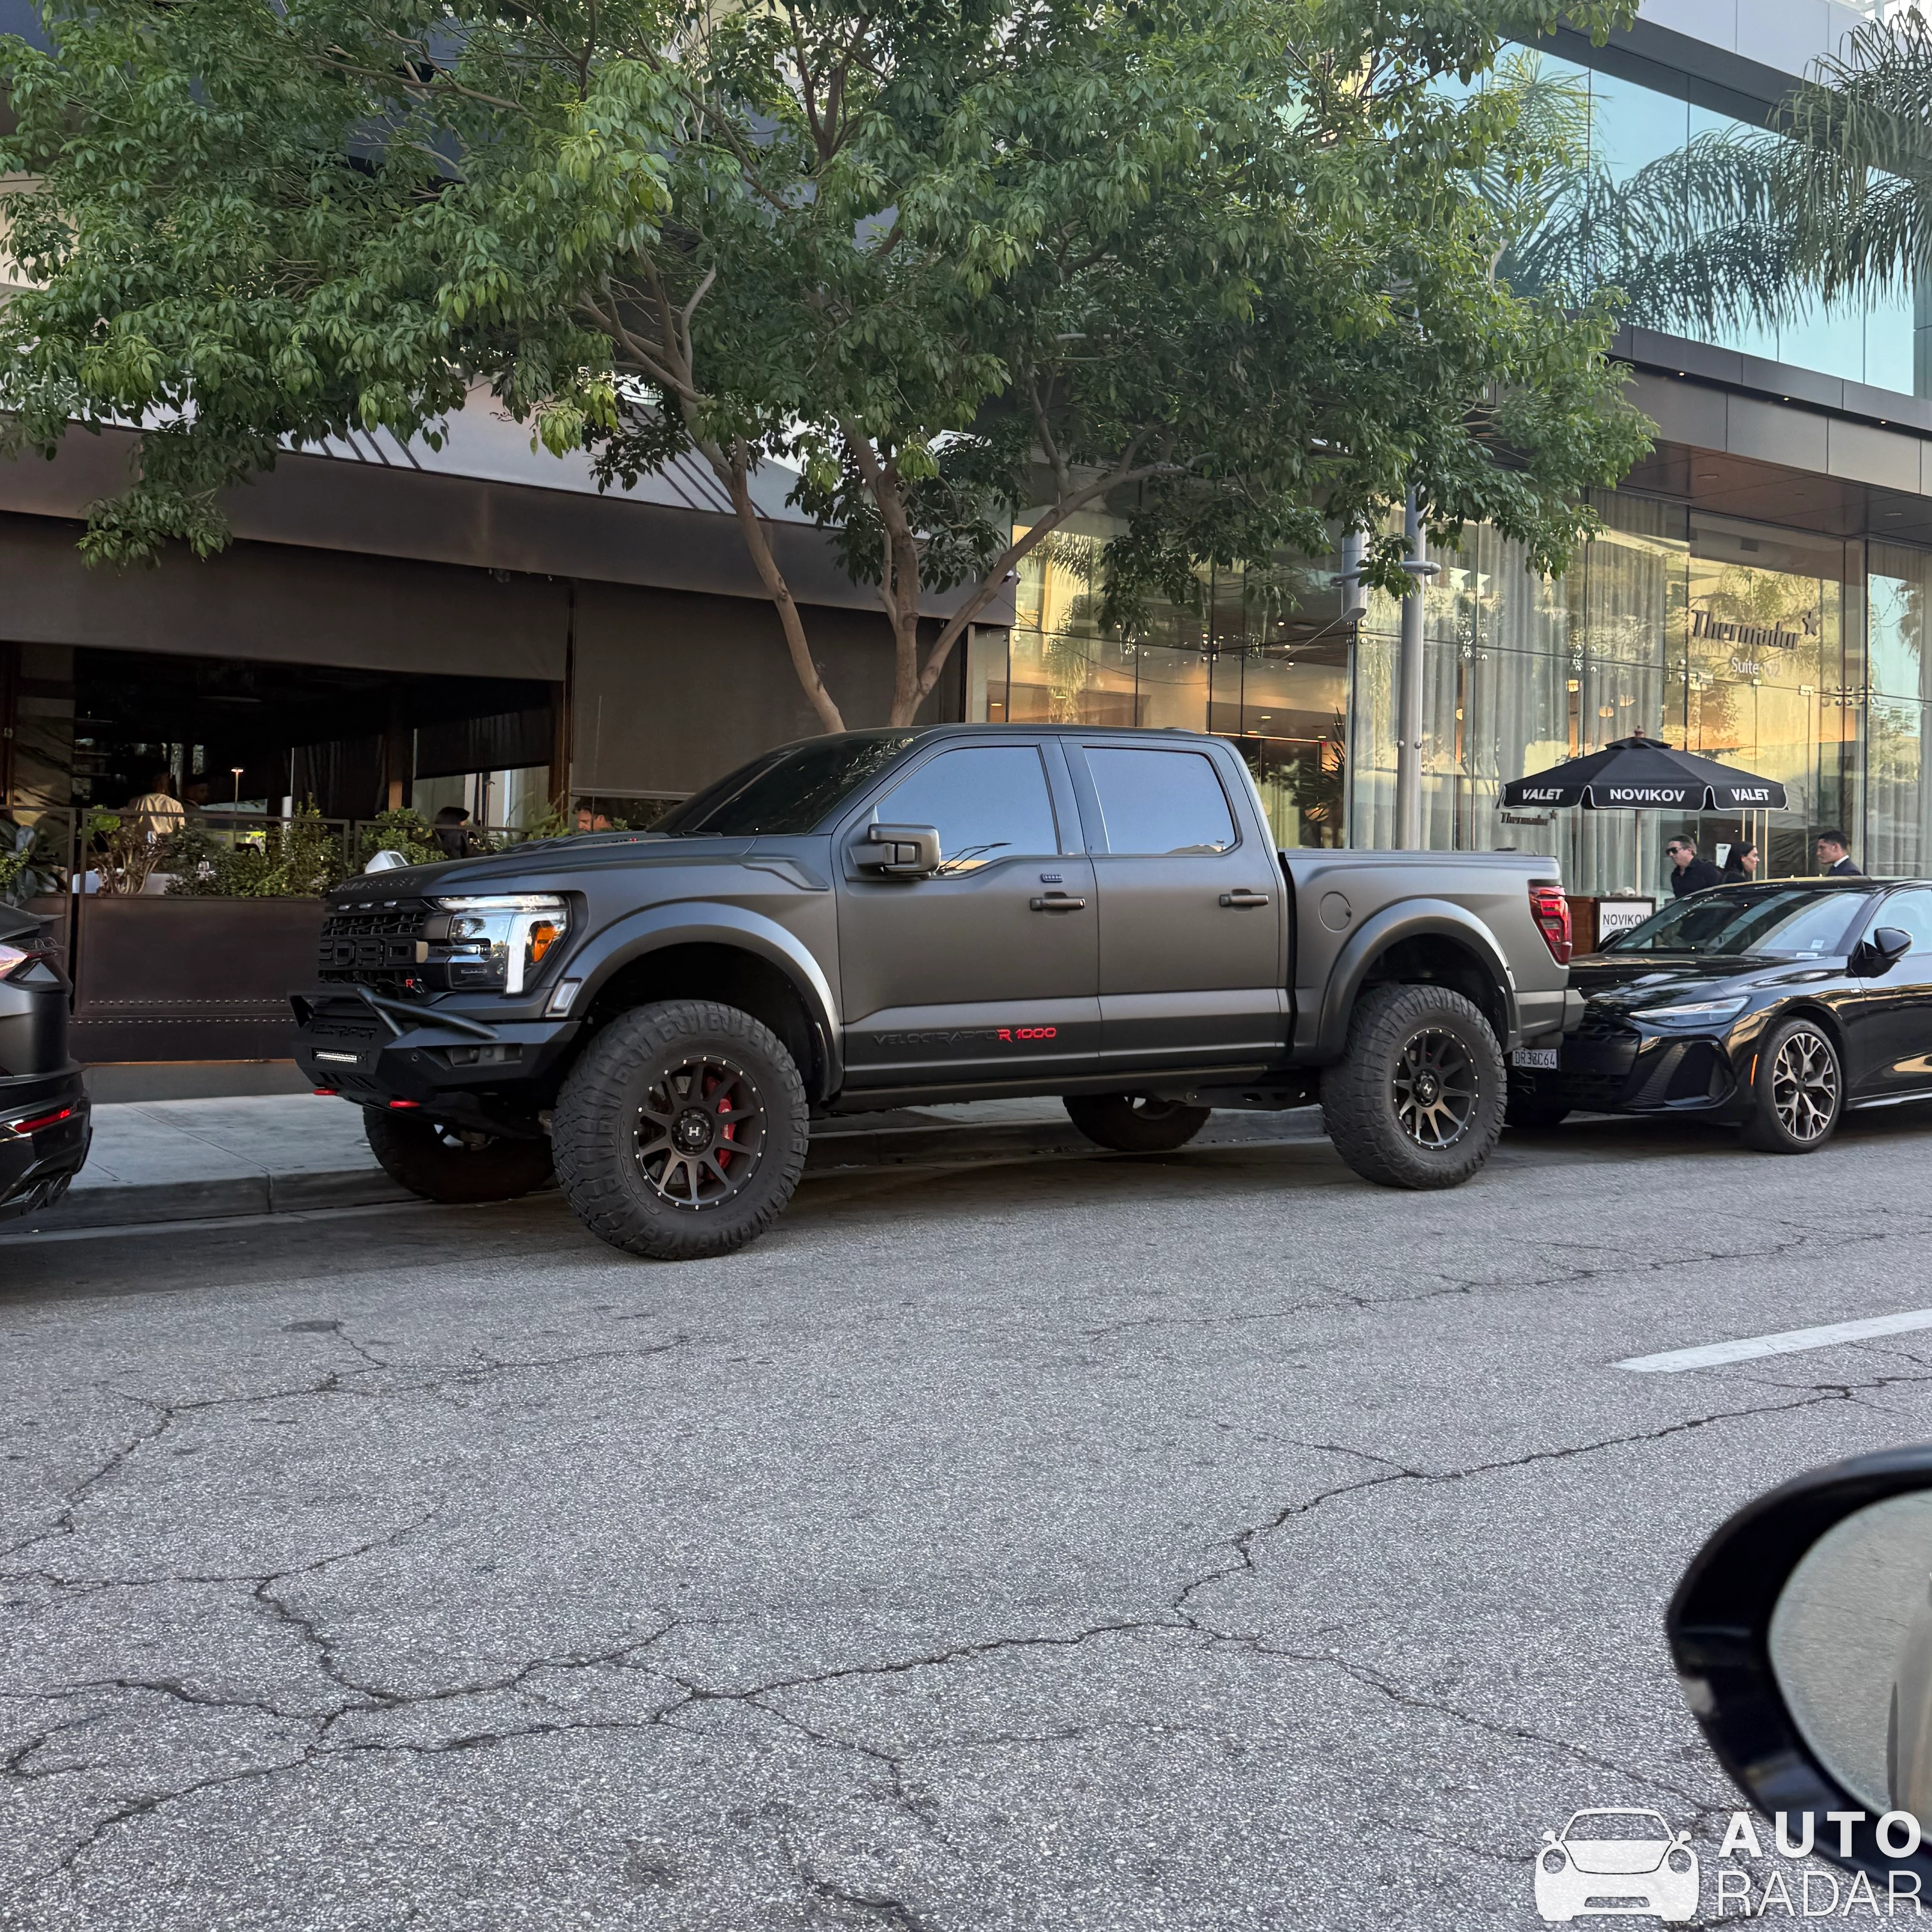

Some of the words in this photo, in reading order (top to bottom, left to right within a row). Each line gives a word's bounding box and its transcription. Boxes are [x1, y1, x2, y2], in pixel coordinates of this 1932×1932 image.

[1691, 610, 1801, 650] Thermador
[1731, 657, 1759, 675] Suite
[1522, 789, 1563, 800] VALET
[1610, 789, 1686, 802] NOVIKOV
[1731, 789, 1769, 801] VALET
[874, 1029, 1013, 1045] VELOCRAPTOR
[1015, 1027, 1057, 1039] 1000
[688, 1127, 700, 1136] H
